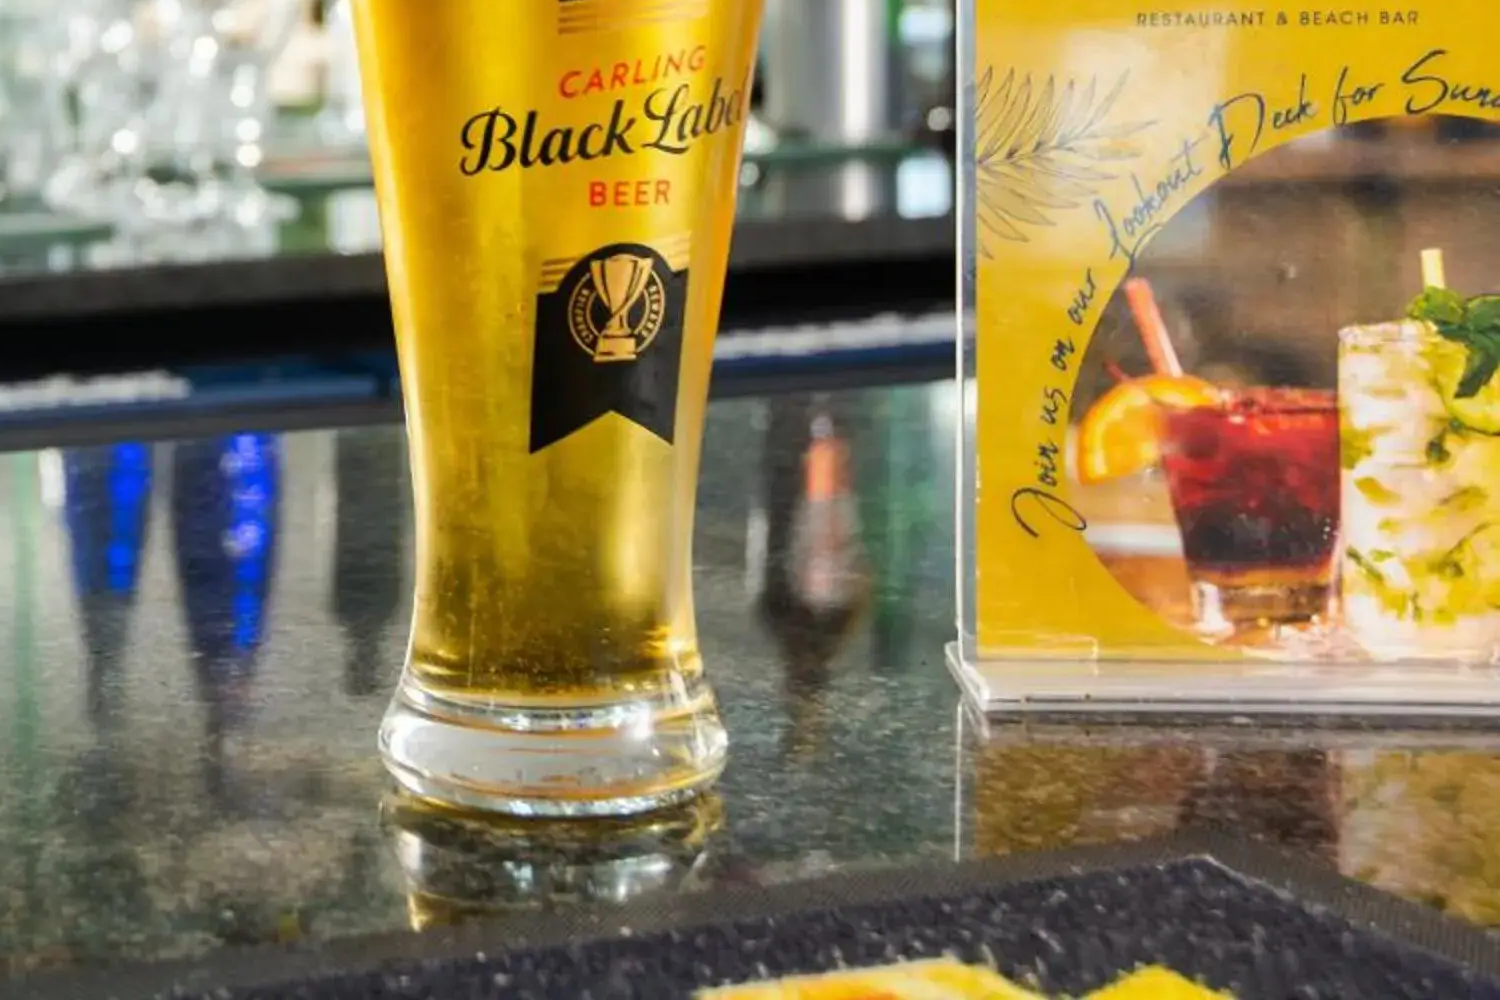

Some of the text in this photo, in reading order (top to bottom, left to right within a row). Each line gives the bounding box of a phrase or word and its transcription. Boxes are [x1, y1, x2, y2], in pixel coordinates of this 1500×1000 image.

[1136, 10, 1419, 27] RESTAURANT & BEACH BAR
[559, 44, 706, 99] CARLING
[1332, 65, 1386, 129] for
[459, 99, 636, 176] Black
[1208, 72, 1315, 169] Deck
[589, 180, 671, 208] BEER
[1093, 135, 1211, 269] Lookout
[1066, 267, 1097, 327] our
[1050, 336, 1075, 371] on
[1040, 386, 1068, 428] us
[1011, 439, 1087, 540] Join
